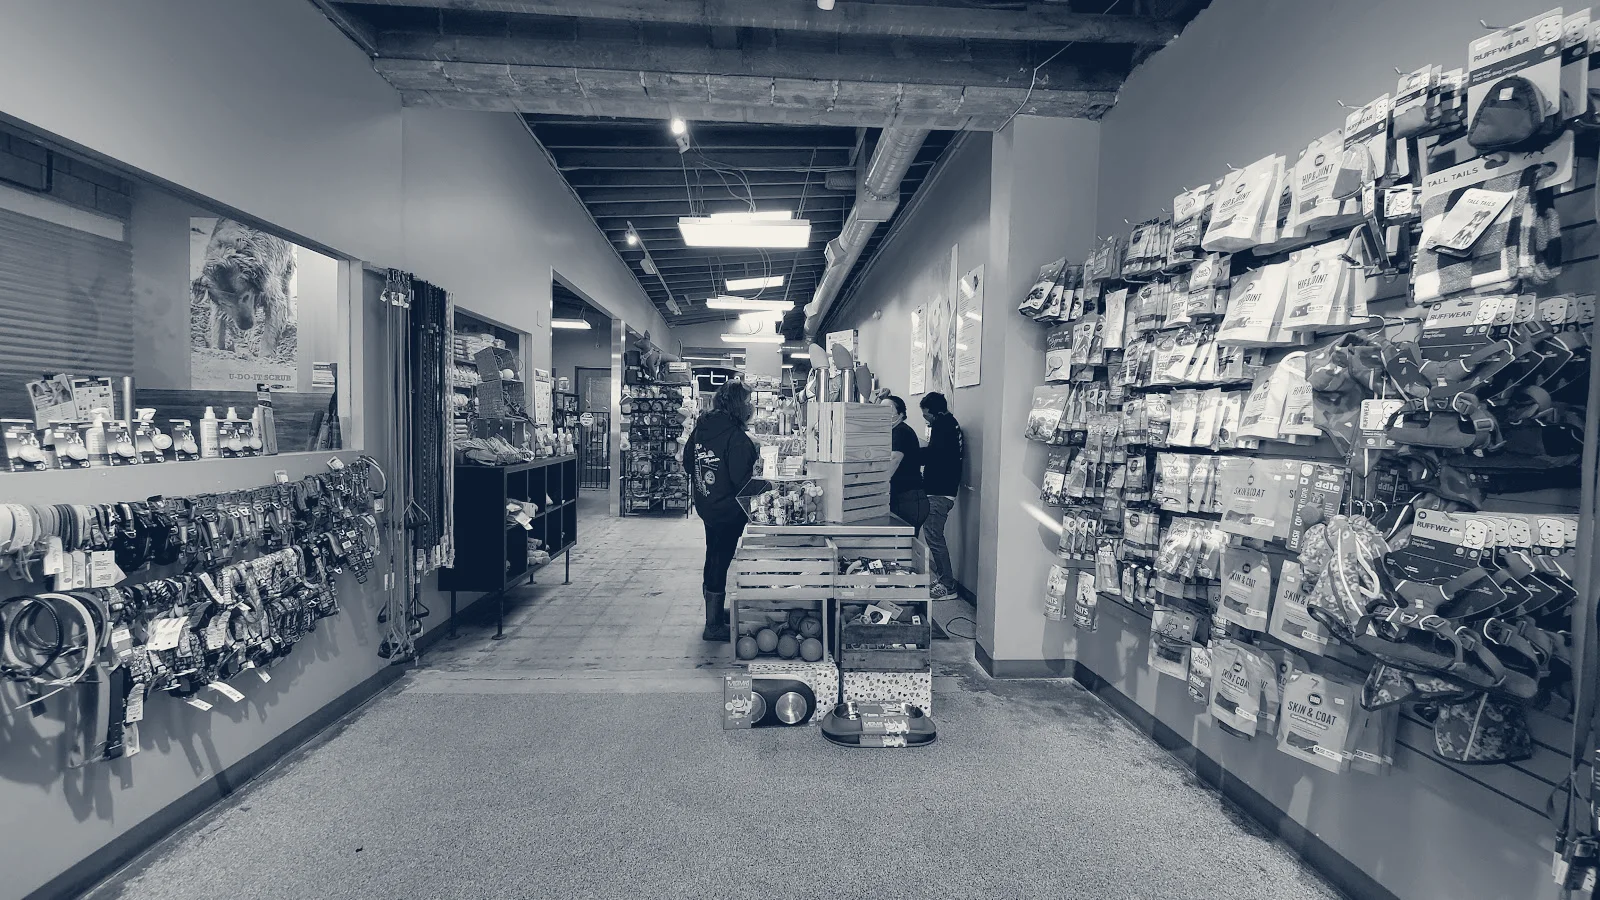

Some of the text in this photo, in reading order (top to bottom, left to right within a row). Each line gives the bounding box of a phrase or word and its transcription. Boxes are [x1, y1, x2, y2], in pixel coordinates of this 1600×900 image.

[1473, 37, 1529, 62] RUFFWEAR
[1427, 167, 1479, 188] TALL TAILS
[1430, 310, 1472, 321] RUFFWEAR
[229, 373, 292, 382] U-DO-IT SCRUB
[1293, 504, 1306, 527] COR
[1416, 520, 1460, 533] RUFFWEA
[1290, 530, 1301, 549] LEASH
[1284, 589, 1307, 606] SKIN &
[1221, 668, 1232, 680] SKIN
[1288, 701, 1307, 715] SKIN
[1307, 707, 1314, 718] &
[1315, 710, 1338, 725] COAT
